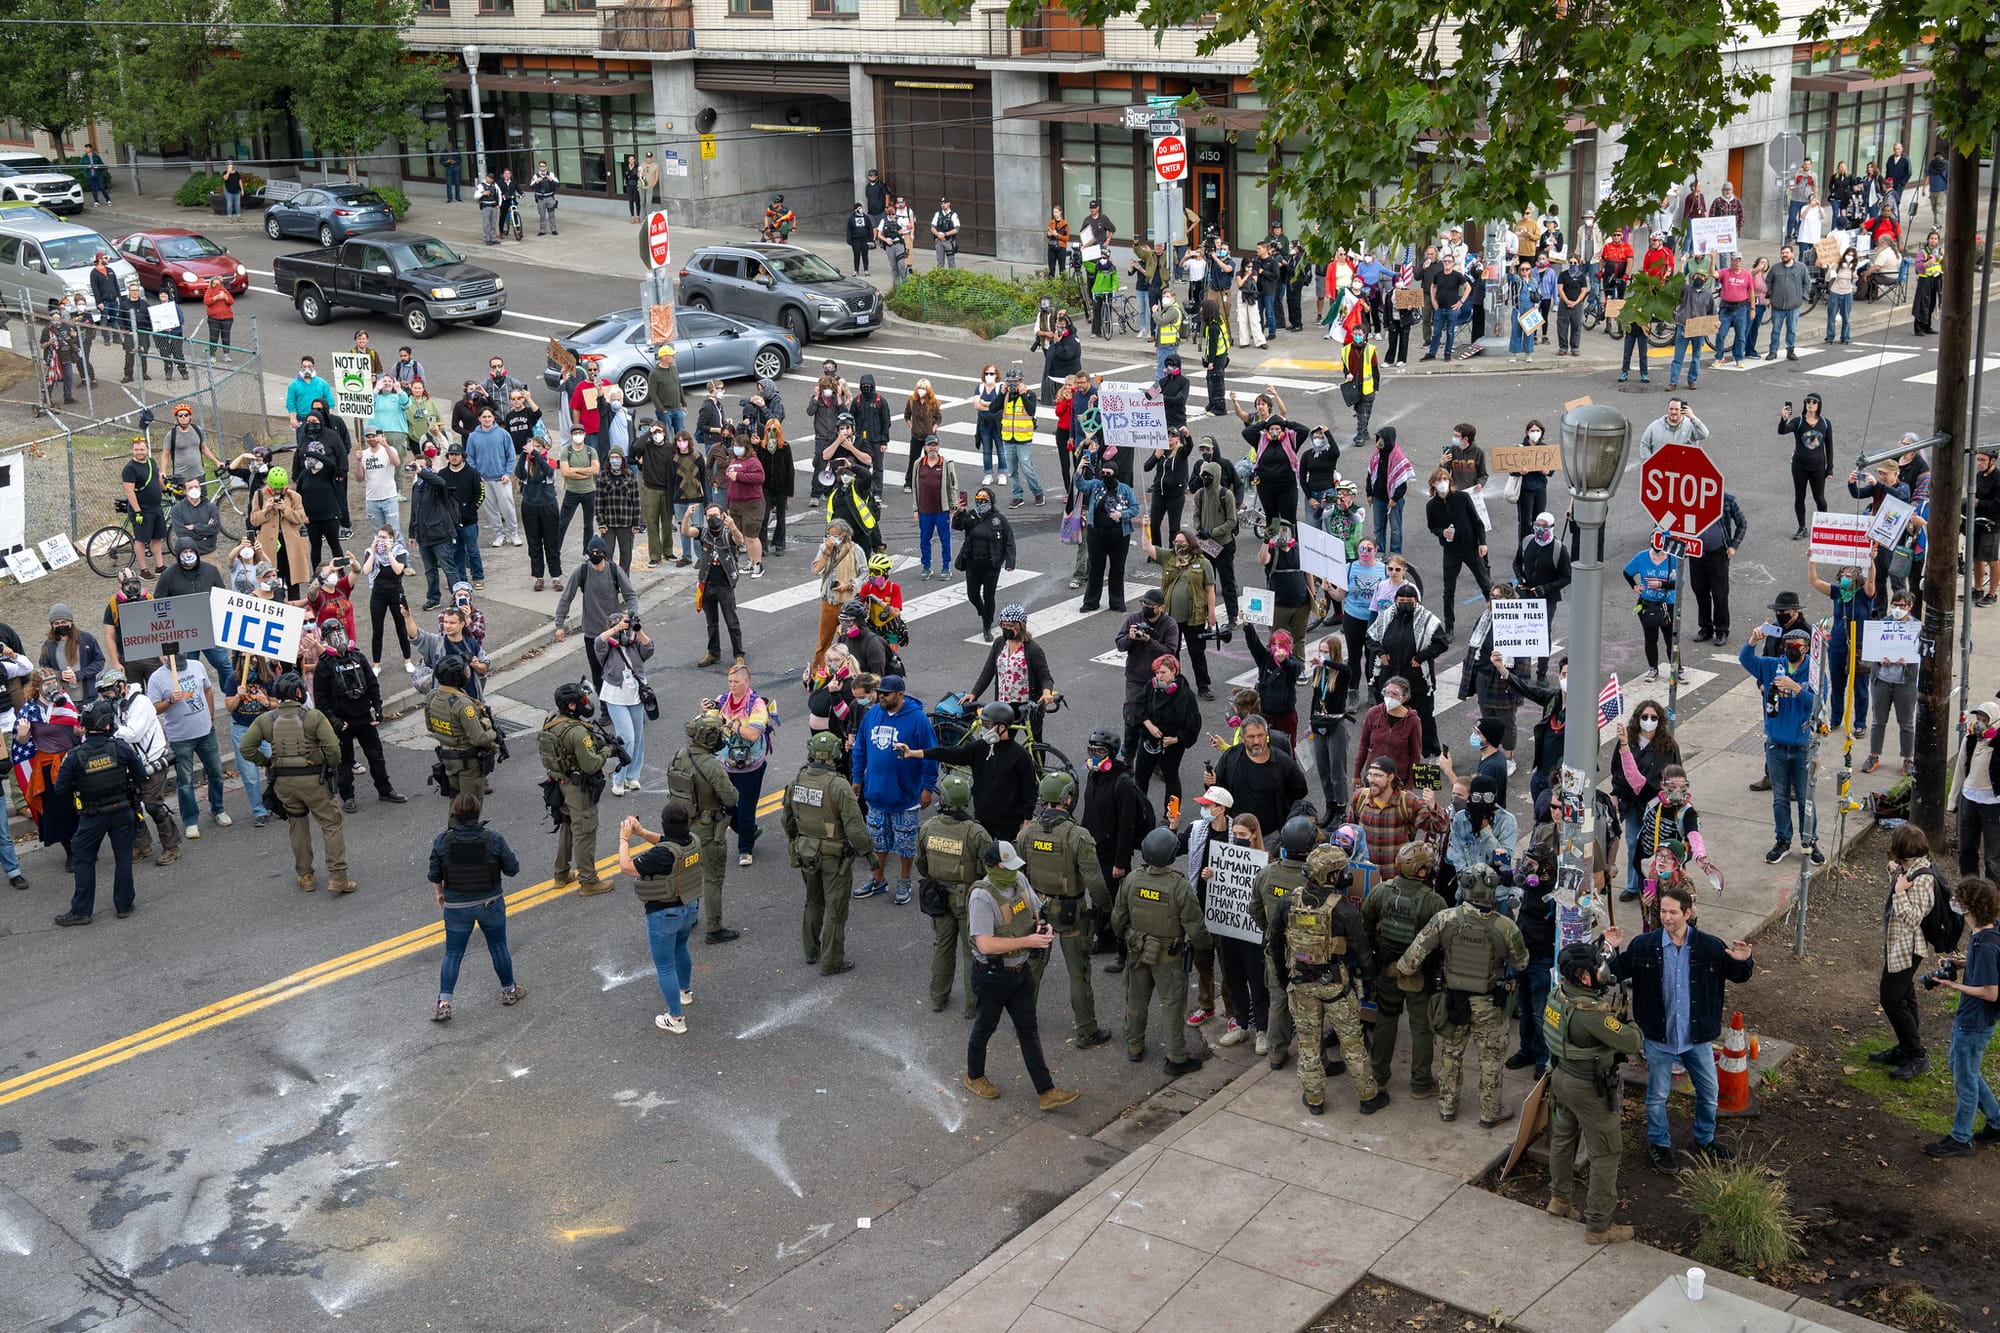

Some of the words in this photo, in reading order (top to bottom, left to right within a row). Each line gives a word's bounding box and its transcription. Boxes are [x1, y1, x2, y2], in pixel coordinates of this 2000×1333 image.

[1200, 152, 1220, 160] 4150
[1162, 164, 1180, 173] ENTER
[652, 224, 657, 232] DO
[658, 221, 666, 230] NOT
[653, 246, 665, 256] ENTER
[335, 356, 354, 369] NOT
[356, 357, 369, 370] UR
[1102, 395, 1124, 412] NO
[1103, 413, 1129, 429] YES
[1131, 412, 1151, 420] FREE
[1131, 419, 1162, 428] SPEECH
[1106, 430, 1128, 443] NO
[1496, 453, 1520, 471] ICE
[1646, 468, 1719, 509] STOP
[48, 539, 58, 549] NO
[153, 600, 171, 613] ICE
[227, 596, 285, 618] ABOLISH
[151, 619, 175, 631] NAZI
[1883, 622, 1906, 633] ICE
[123, 628, 198, 648] BROWNSHIRTS
[221, 611, 285, 655] ICE
[1880, 633, 1895, 642] ARE
[1898, 633, 1912, 641] THE
[1495, 640, 1521, 648] ABOLISH
[1525, 638, 1539, 646] ICE!
[429, 716, 452, 730] POLICE
[88, 756, 112, 768] POLICE
[928, 836, 963, 850] Federal
[1034, 840, 1053, 851] POLICE
[1220, 845, 1251, 861] YOUR
[685, 852, 699, 868] ERO
[1215, 871, 1226, 883] IS
[1140, 889, 1160, 900] POLICE
[1209, 882, 1253, 901] IMPORTAN
[1012, 900, 1025, 914] HSI
[1209, 895, 1234, 909] THAN
[1389, 903, 1411, 916] POLICE
[1206, 907, 1240, 929] ORDERS
[1464, 934, 1482, 944] POLICE
[1546, 1005, 1561, 1024] POLICE
